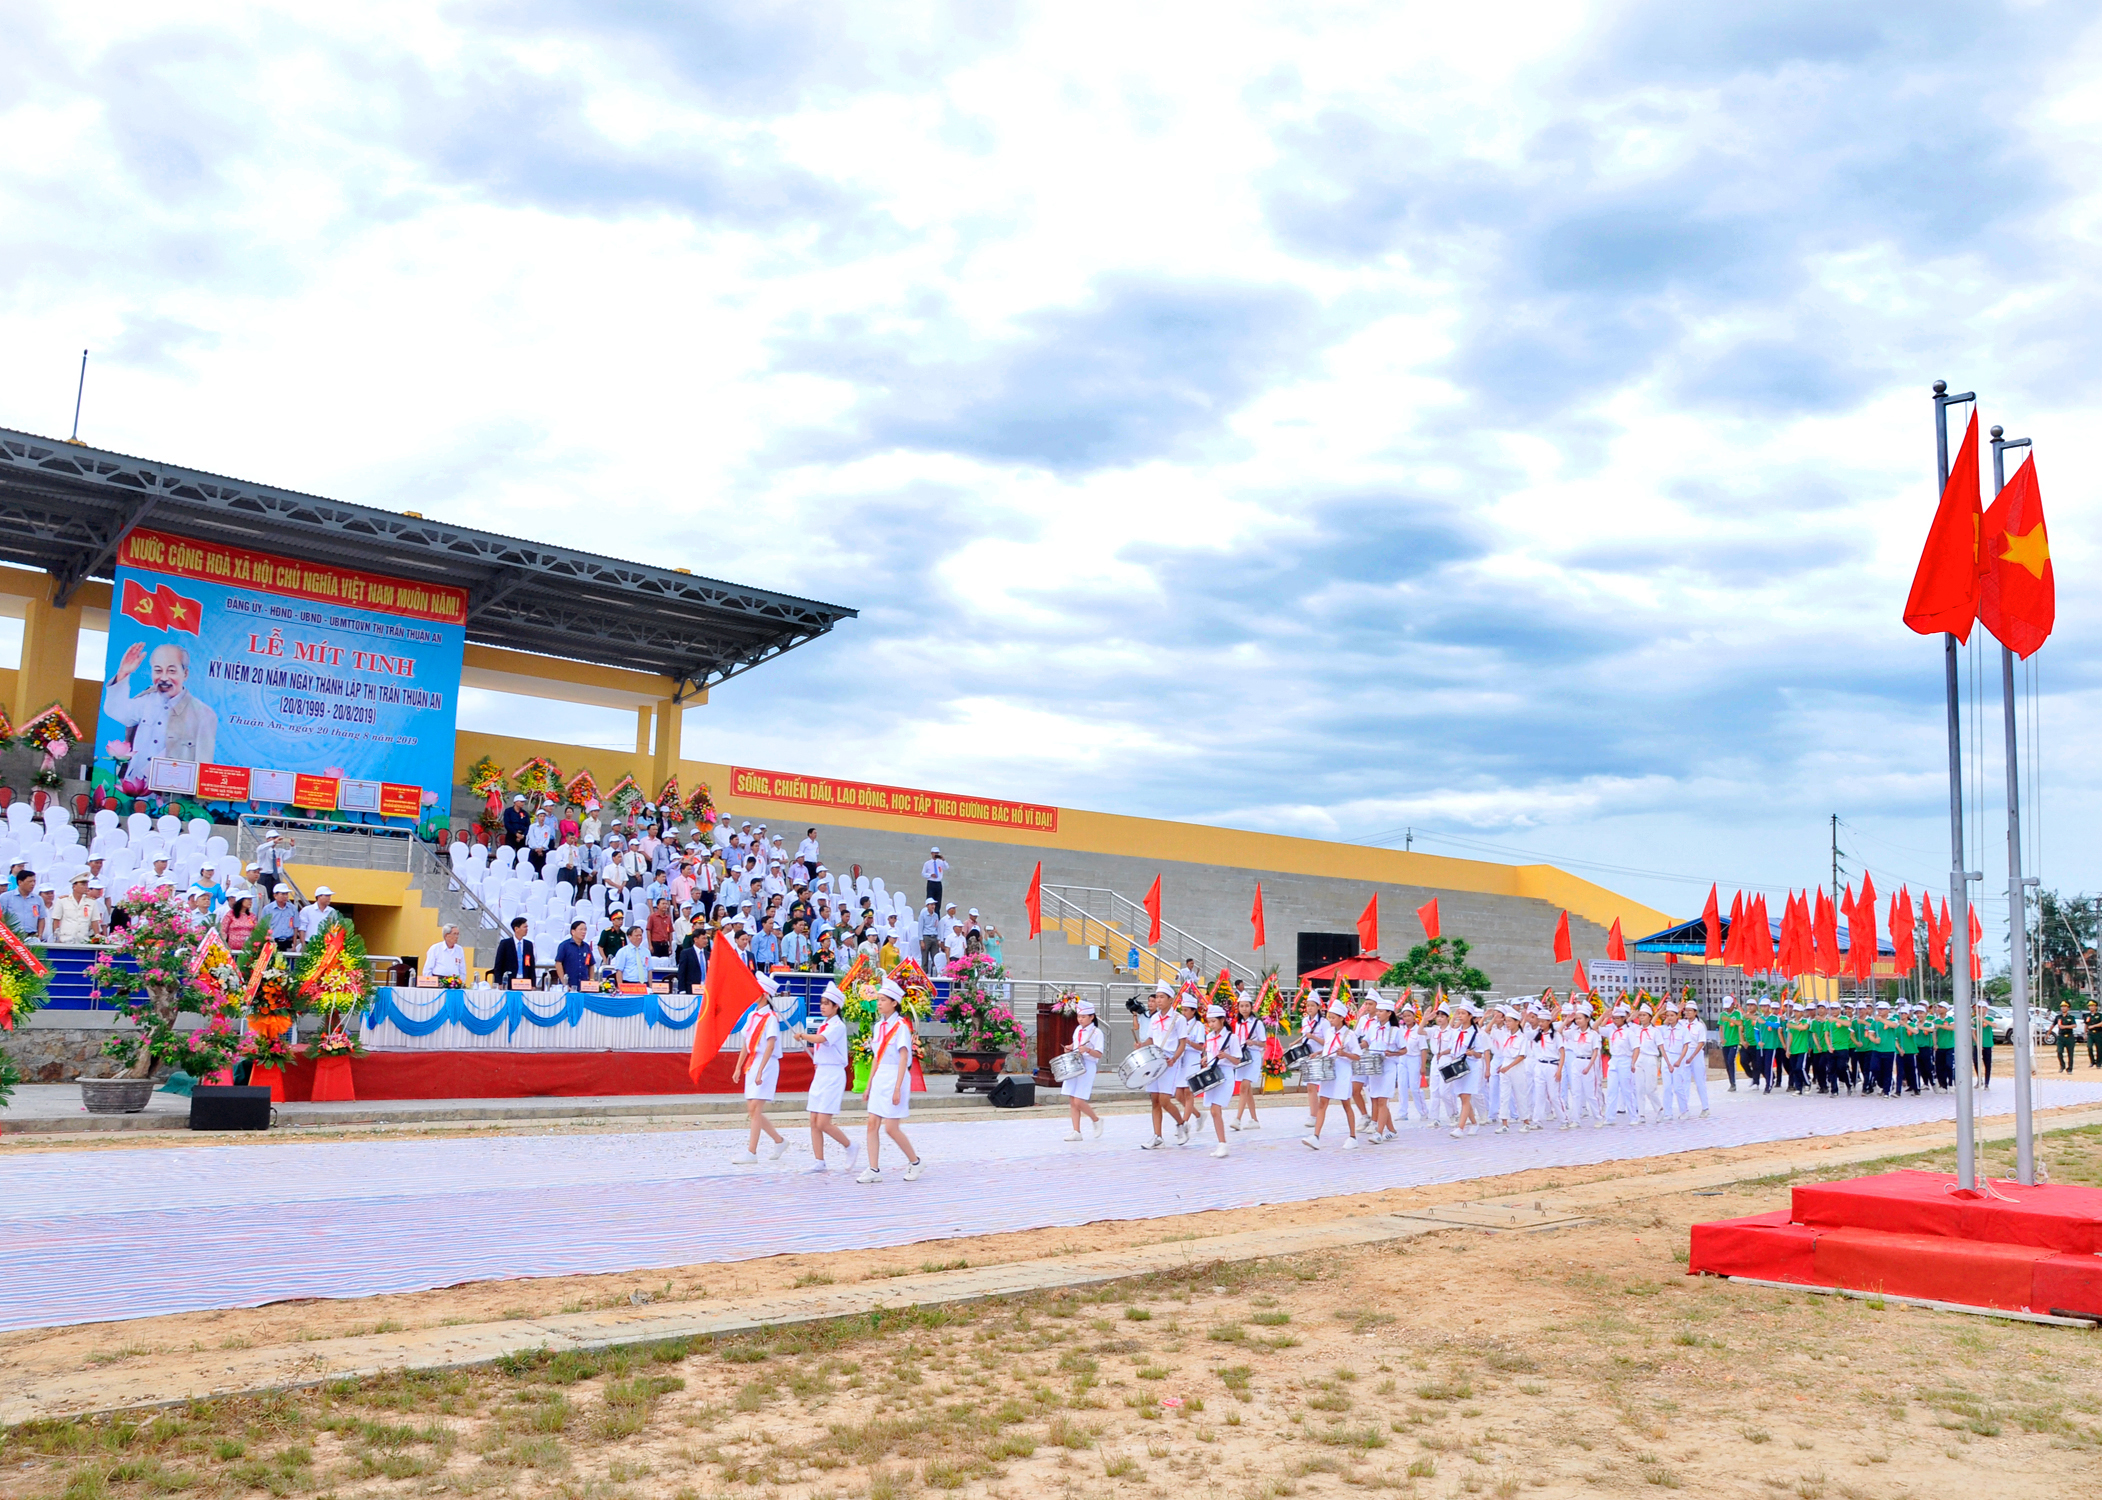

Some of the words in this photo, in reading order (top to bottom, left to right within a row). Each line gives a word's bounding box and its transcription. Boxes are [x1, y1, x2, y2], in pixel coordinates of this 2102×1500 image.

[130, 537, 165, 563] NƯỚC
[168, 543, 203, 572] CỘNG
[206, 552, 230, 576] HOÀ
[233, 556, 250, 580] XÃ
[253, 560, 272, 588] HỘI
[276, 564, 300, 589] CHỦ
[303, 572, 338, 596] NGHĨA
[342, 577, 365, 604] VIỆT
[368, 584, 394, 606] NAM
[397, 587, 427, 611] MUÔN
[431, 592, 460, 616] NĂM!
[227, 597, 249, 611] ĐẢNG
[270, 606, 292, 618] HĐND
[301, 612, 322, 623] UBND
[330, 616, 370, 631] UBMTTQVN
[373, 623, 384, 636] THỊ
[386, 623, 405, 638] TRẤN
[407, 629, 430, 643] THUẬN
[432, 633, 442, 644] AN
[248, 628, 284, 657] LỄ
[293, 640, 345, 666] MÍT
[352, 650, 416, 677] TINH
[209, 656, 222, 678] KỶ
[224, 661, 250, 684] NIỆM
[252, 668, 263, 684] 20
[266, 667, 287, 687] NĂM
[290, 670, 313, 691] NGÀY
[316, 674, 343, 695] THÀNH
[345, 678, 361, 701] LẬP
[364, 684, 376, 704] THỊ
[379, 682, 400, 704] TRẤN
[402, 687, 429, 710] THUẬN
[430, 694, 442, 710] AN
[229, 715, 264, 727] Thuận
[268, 720, 285, 730] An,
[289, 724, 314, 734] ngày
[317, 726, 328, 734] 20
[331, 728, 360, 740] tháng
[363, 732, 369, 740] 8
[372, 734, 393, 742] năm
[396, 736, 418, 745] 2019
[280, 696, 325, 718] (20/8/1999
[333, 704, 376, 725] 20/8/2019)
[737, 772, 771, 796] SỐNG,
[774, 777, 808, 799] CHIẾN
[810, 781, 834, 804] ĐẤU,
[837, 787, 856, 804] LAO
[858, 788, 889, 810] ĐỘNG,
[892, 794, 911, 813] HỌC
[914, 794, 931, 815] TẬP
[934, 799, 956, 816] THEO
[992, 804, 1009, 822] BÁC
[1026, 808, 1033, 825] VĨ
[1035, 812, 1053, 830] ĐẠI!
